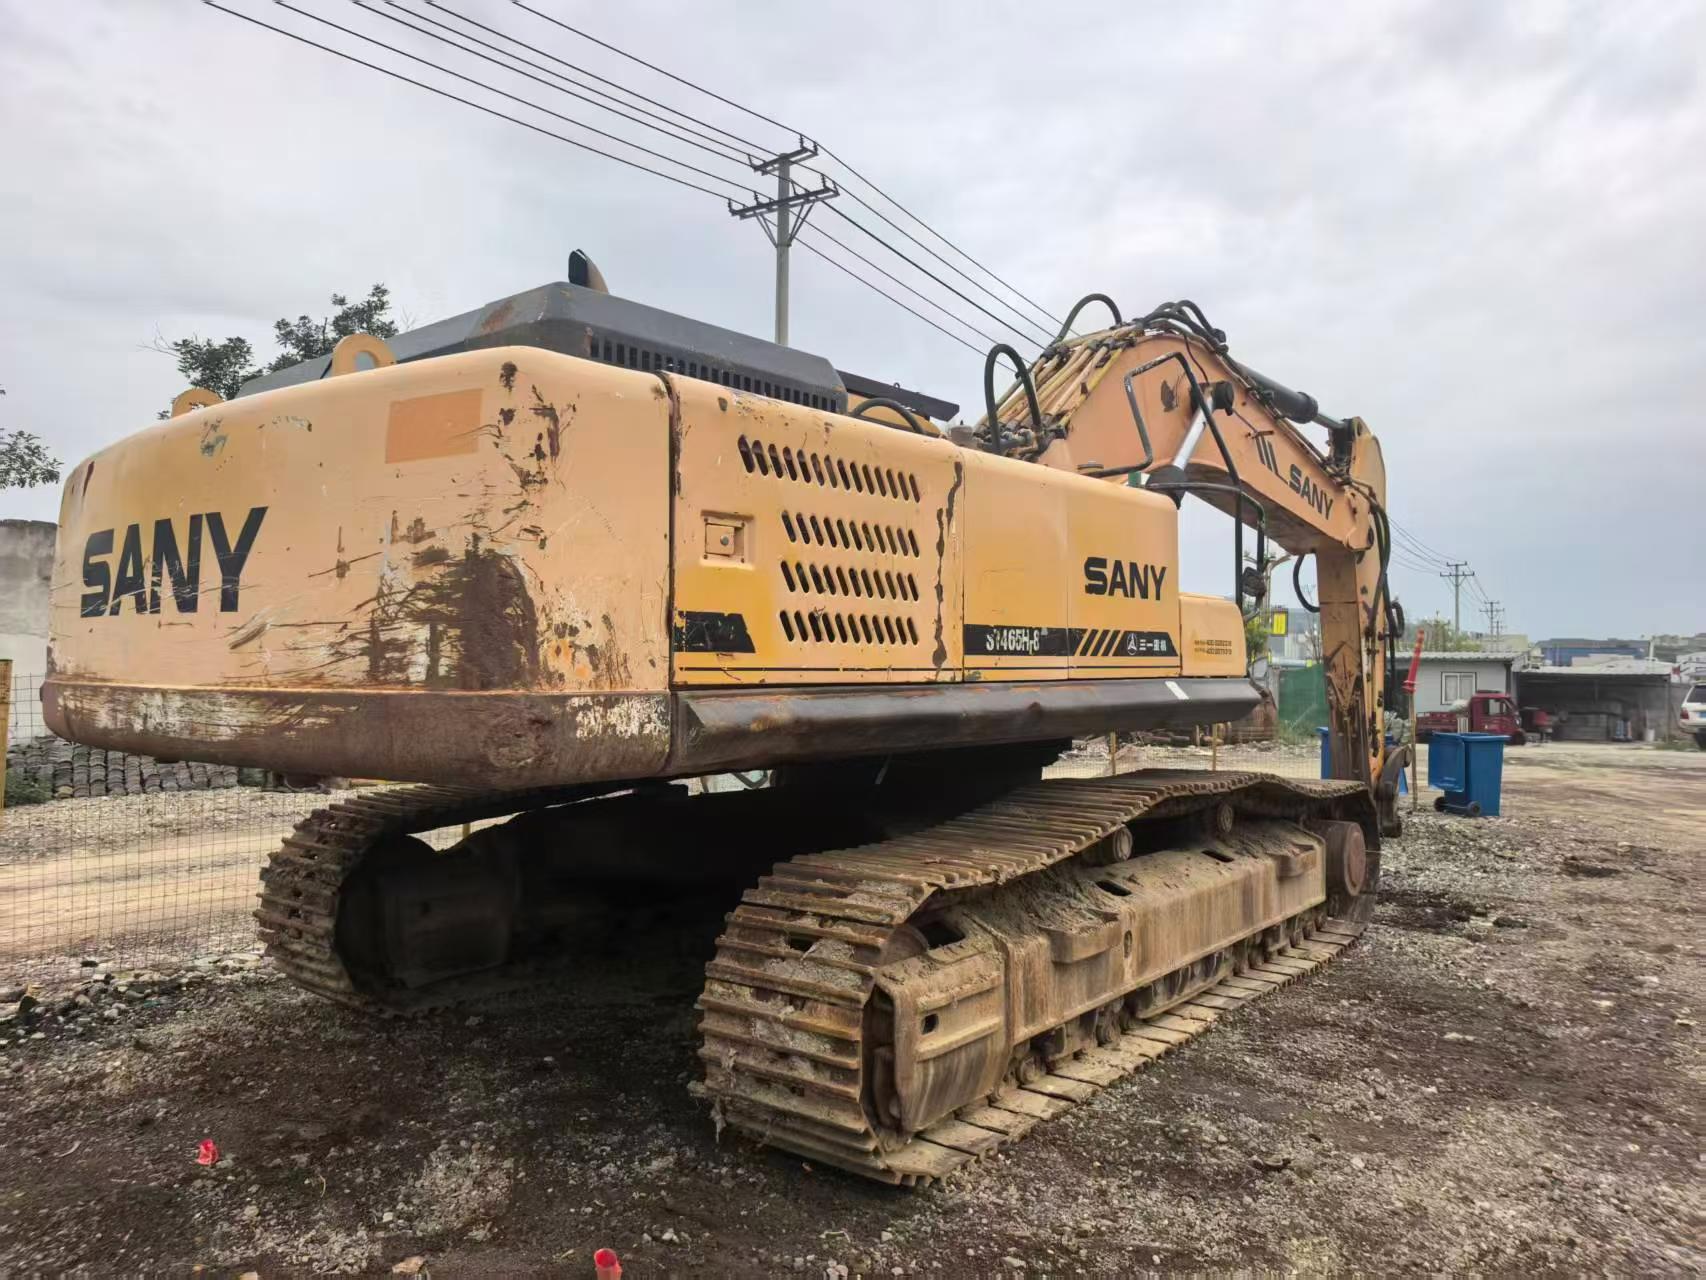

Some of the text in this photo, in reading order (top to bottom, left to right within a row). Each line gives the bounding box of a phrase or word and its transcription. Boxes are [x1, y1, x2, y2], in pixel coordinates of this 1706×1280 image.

[1289, 463, 1334, 521] SANY
[81, 506, 269, 618] SANY
[1084, 557, 1167, 601] SANY
